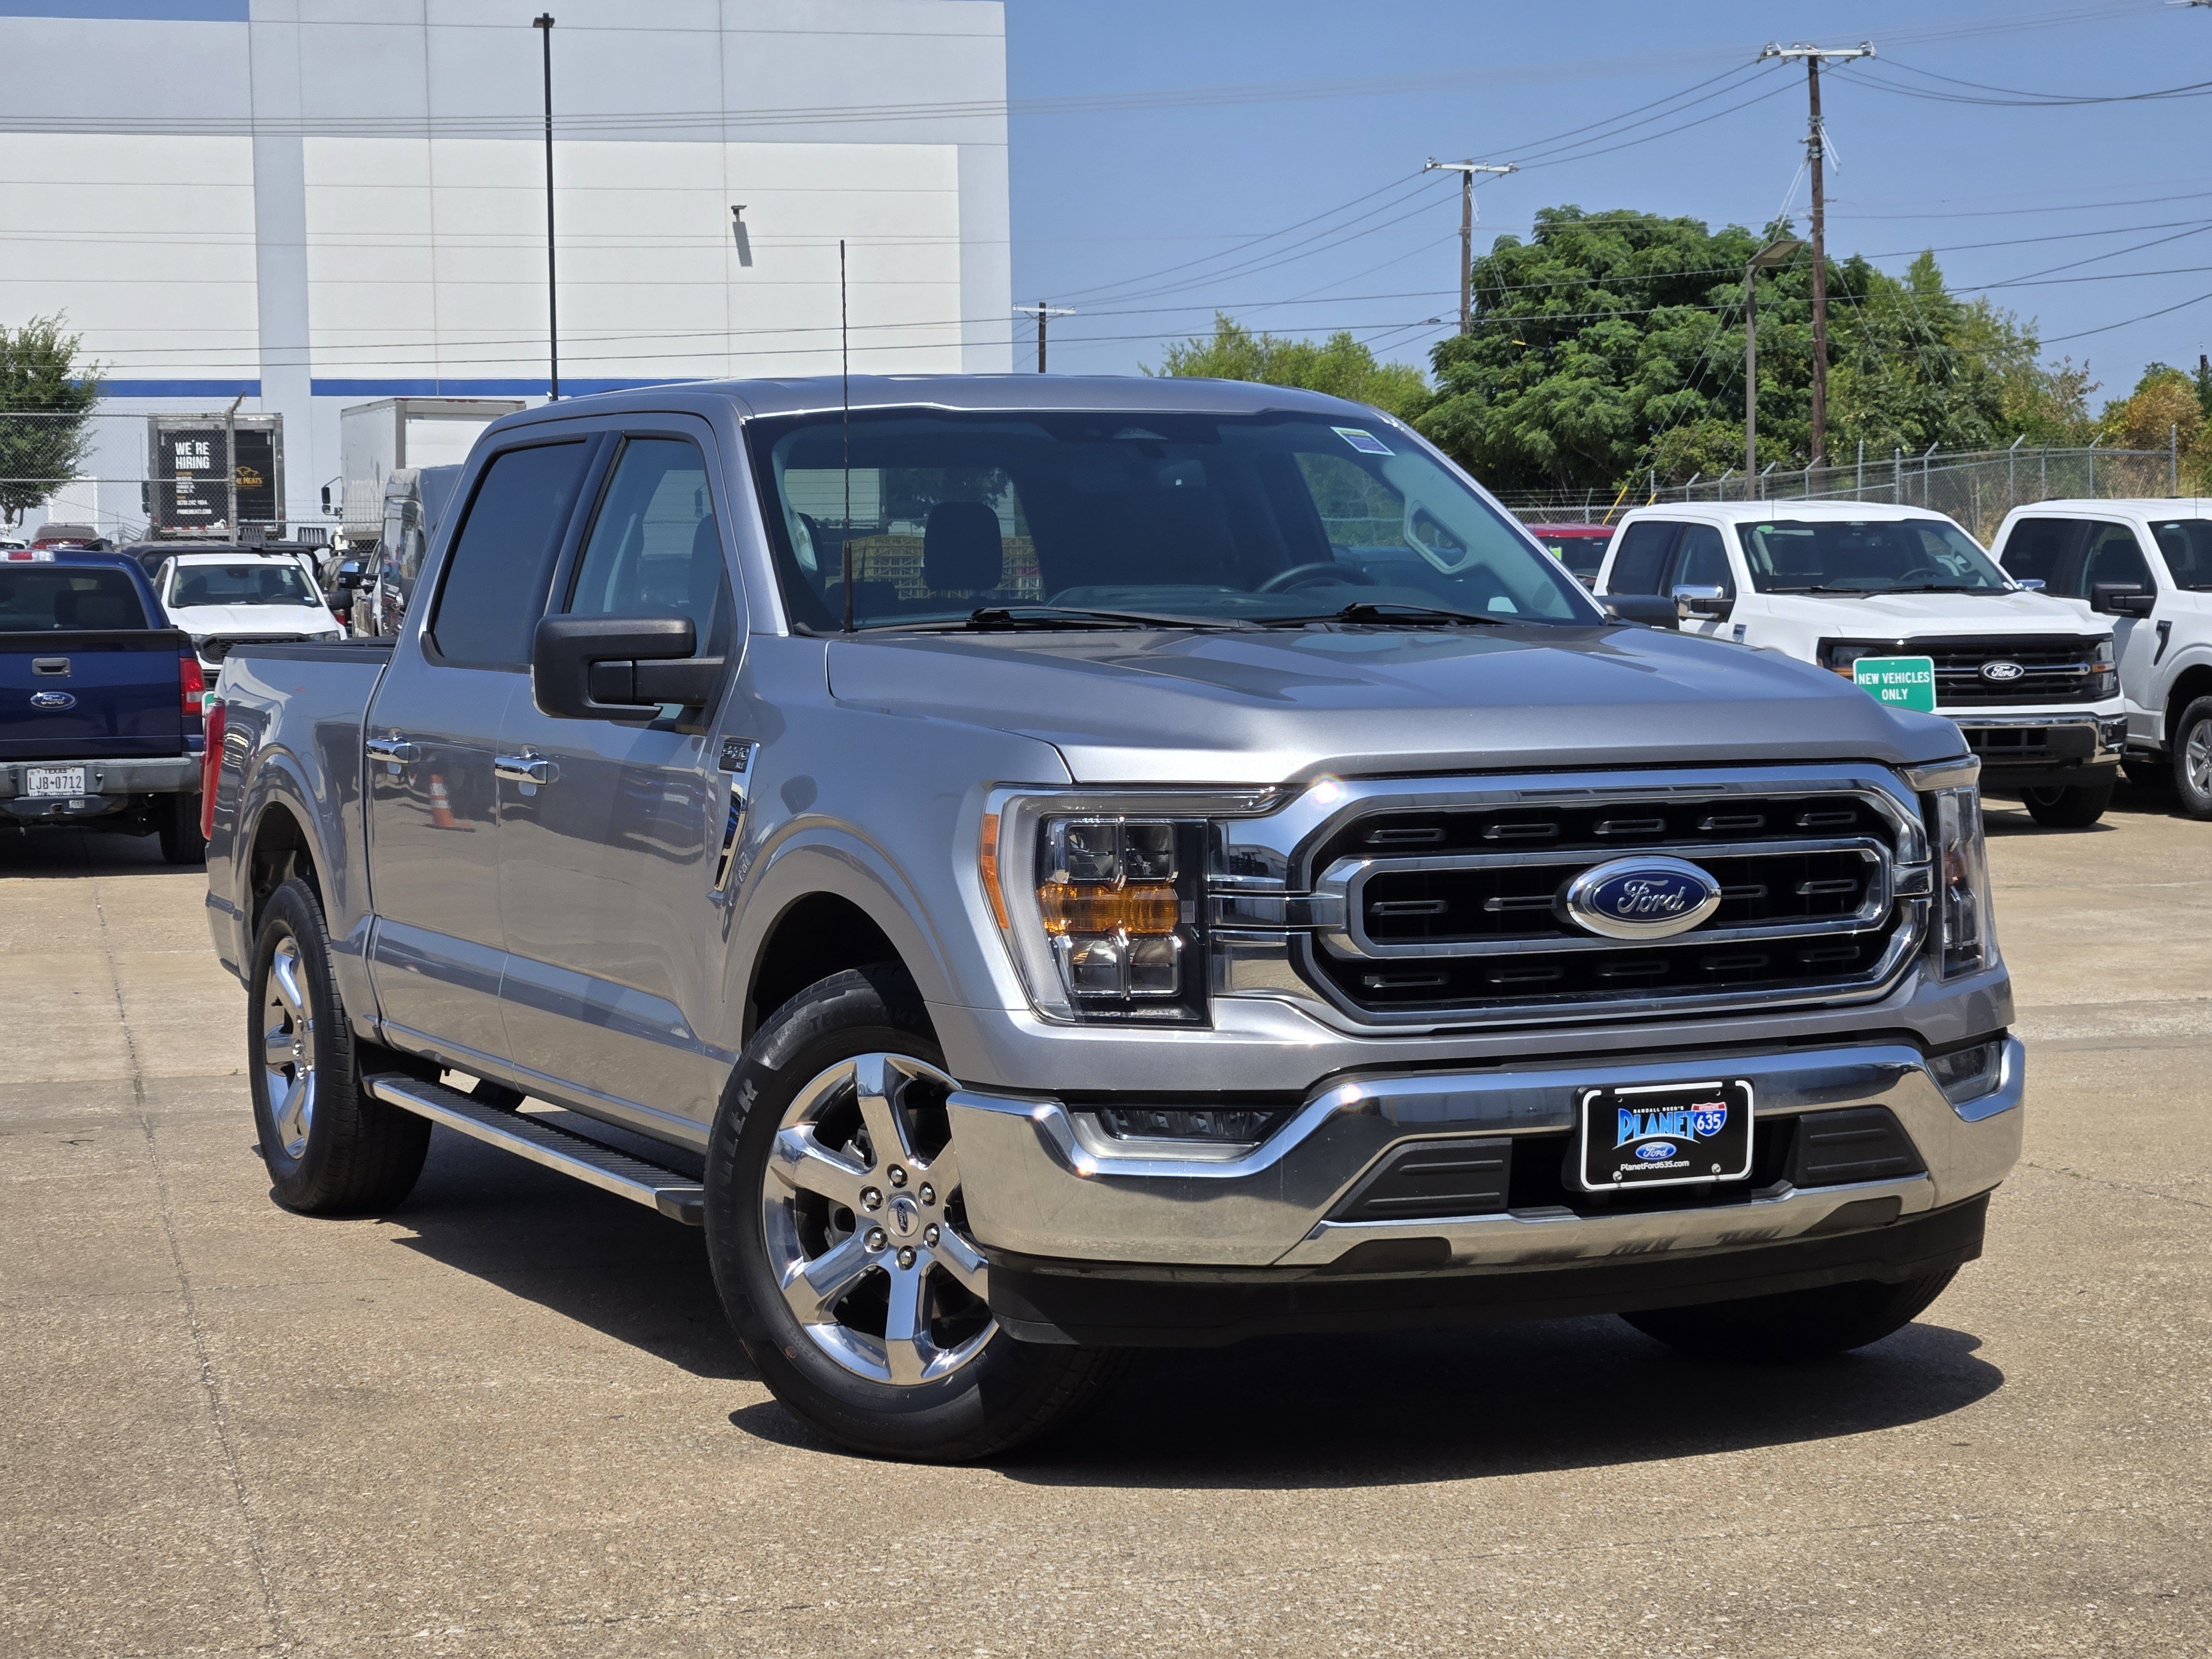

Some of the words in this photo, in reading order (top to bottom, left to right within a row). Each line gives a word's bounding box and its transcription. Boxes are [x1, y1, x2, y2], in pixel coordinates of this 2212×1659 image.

[175, 456, 210, 469] HIRING
[1859, 672, 1879, 685] NEW
[1882, 671, 1930, 684] VEHICLES
[1991, 666, 2016, 677] Ford
[40, 695, 65, 705] Ford
[1881, 688, 1908, 700] ONLY
[29, 777, 49, 790] LJB
[55, 775, 82, 789] 0712
[1617, 879, 1686, 914] Ford
[1618, 1108, 1696, 1146] PLANET
[1697, 1113, 1721, 1130] 635
[1643, 1145, 1668, 1157] Ford
[1620, 1161, 1690, 1171] PlanetFord635.com
[898, 1206, 906, 1228] Ford
